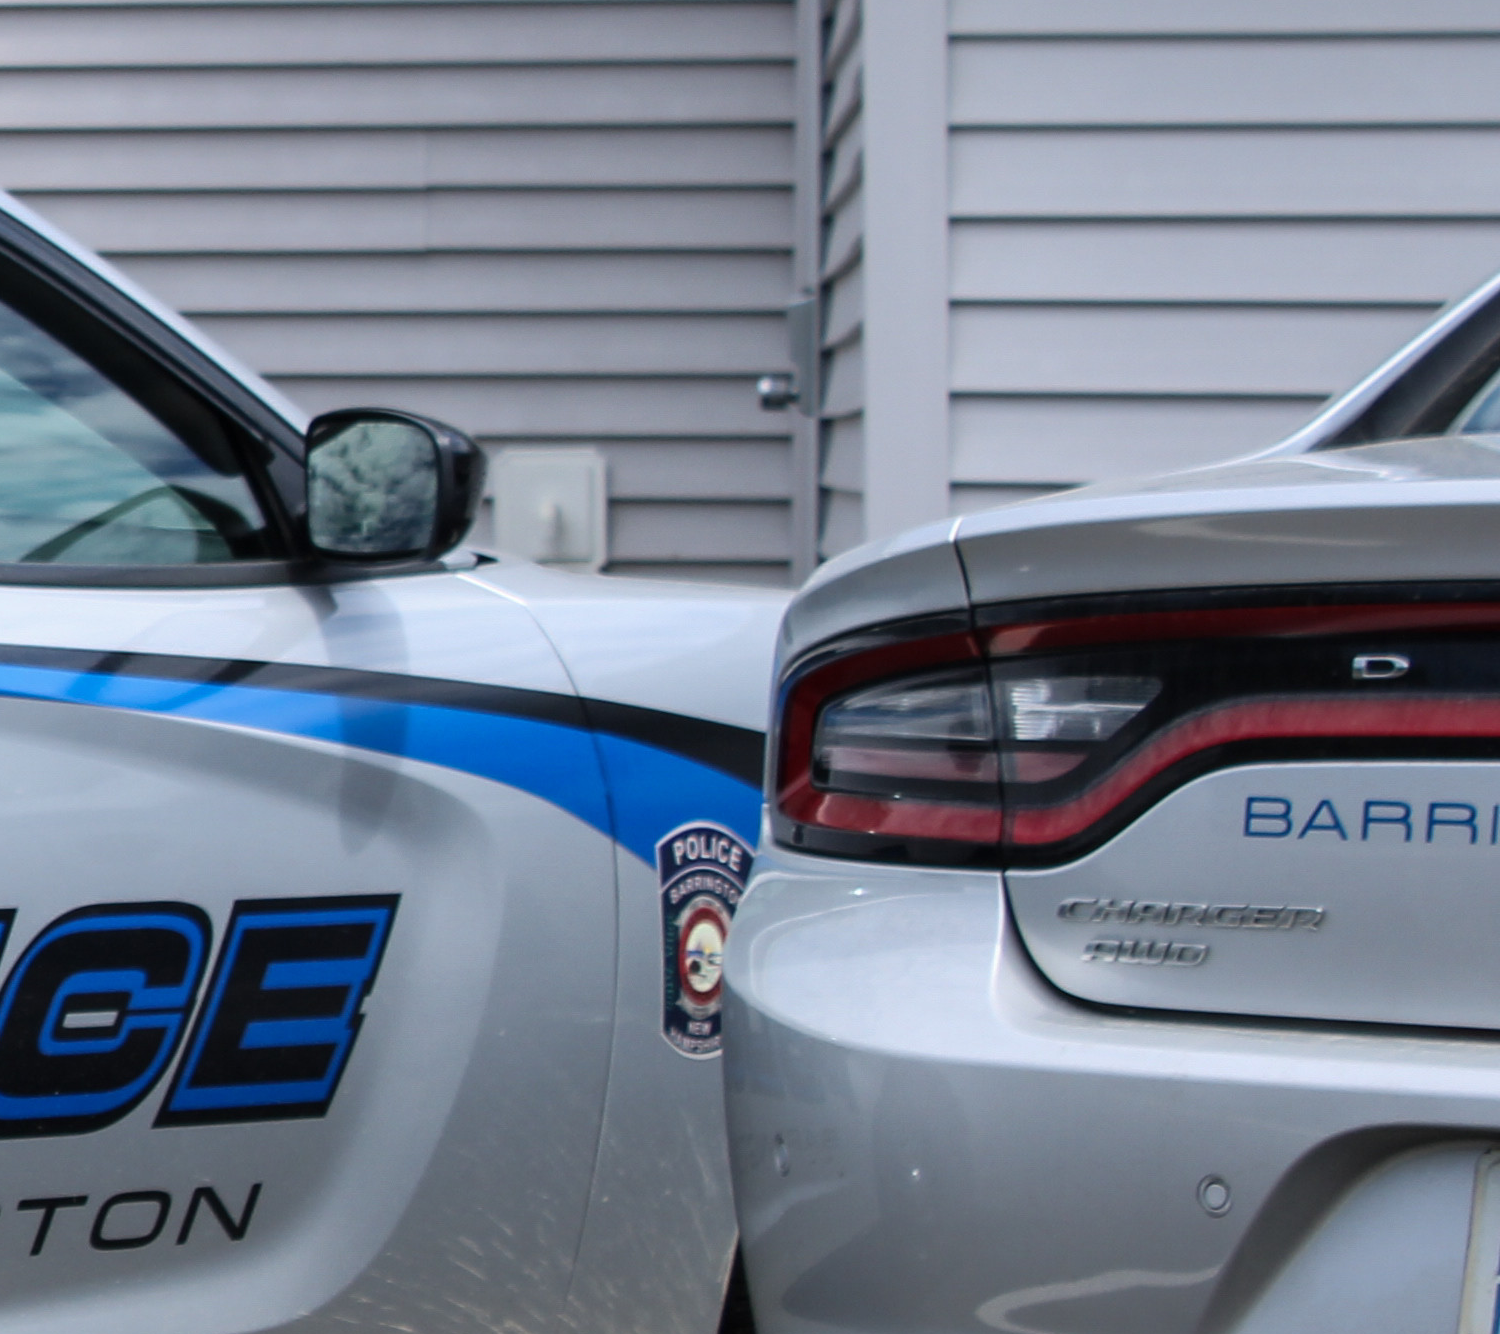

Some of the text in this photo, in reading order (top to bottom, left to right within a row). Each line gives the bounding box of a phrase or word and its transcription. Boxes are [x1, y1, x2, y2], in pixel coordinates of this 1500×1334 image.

[671, 833, 743, 873] POLICE
[668, 874, 741, 905] BARRINGTO
[1056, 897, 1326, 931] CHARGER
[1080, 939, 1211, 967] AWD
